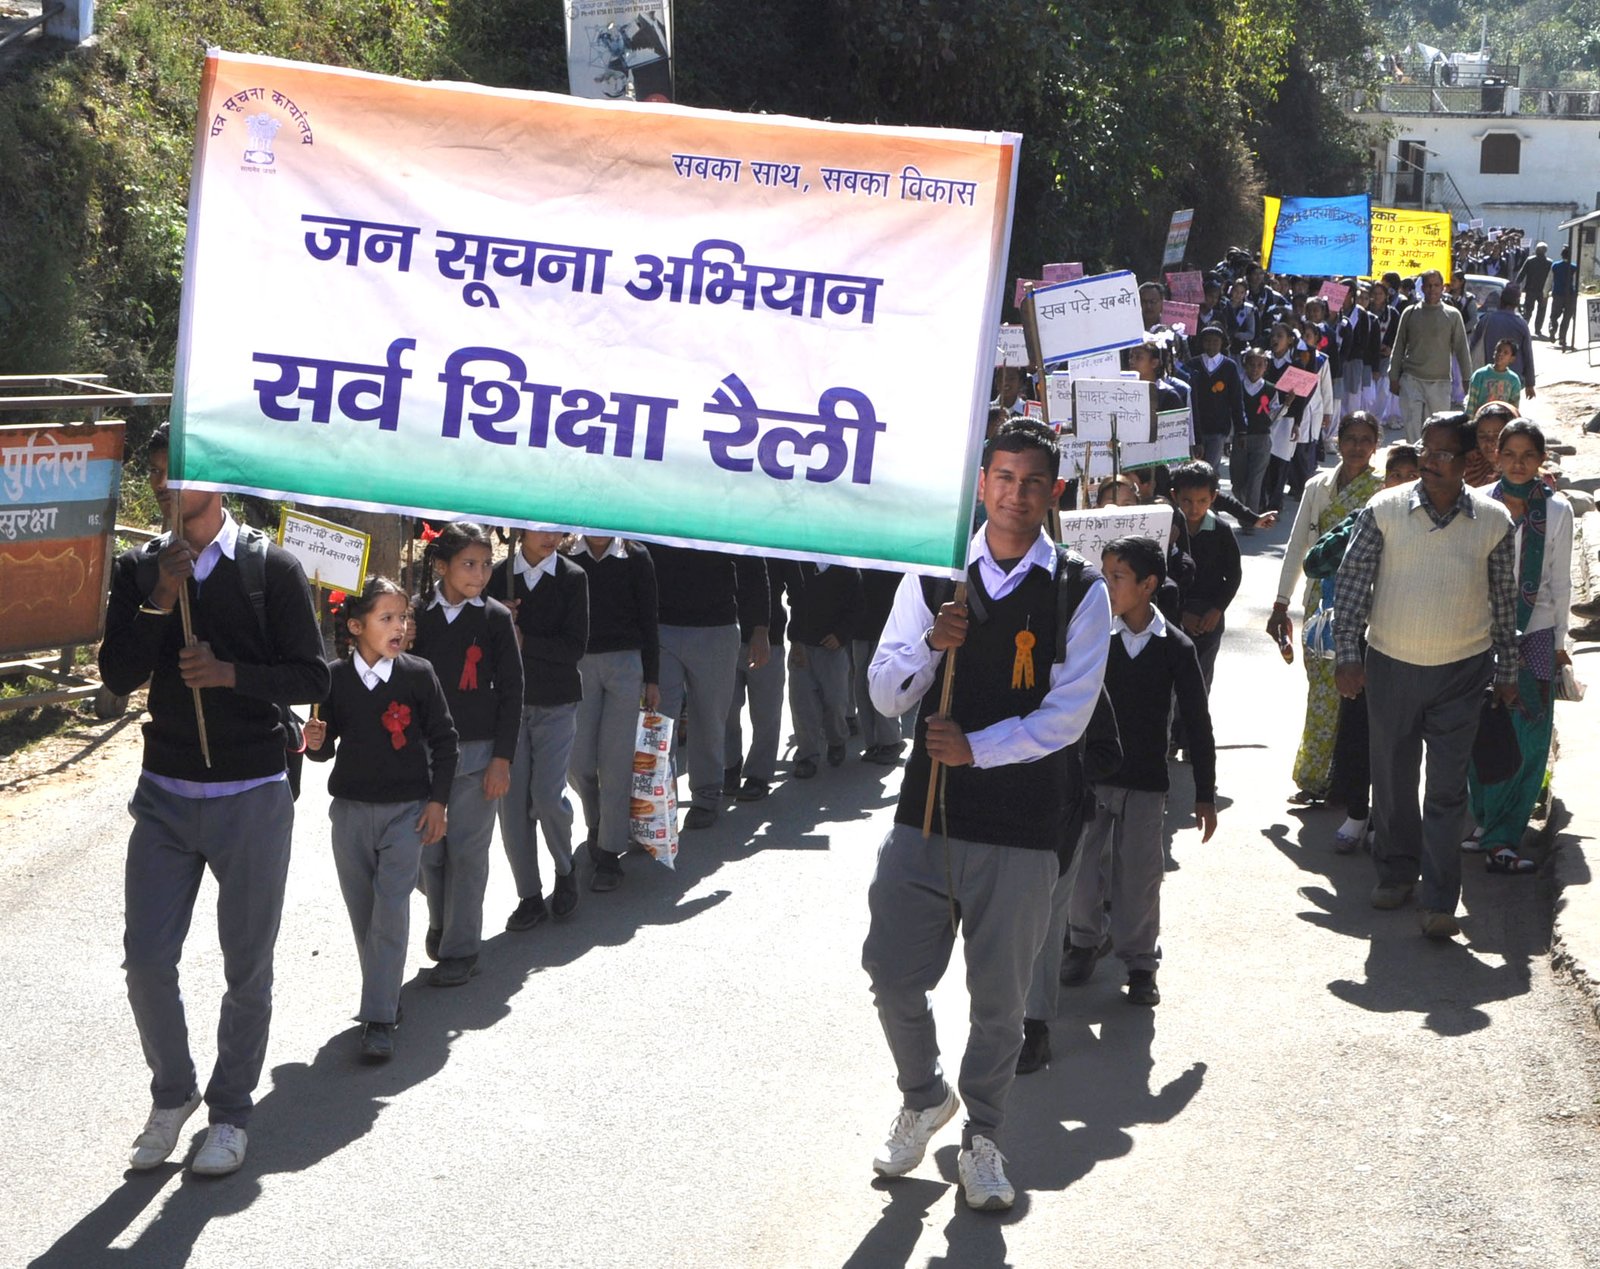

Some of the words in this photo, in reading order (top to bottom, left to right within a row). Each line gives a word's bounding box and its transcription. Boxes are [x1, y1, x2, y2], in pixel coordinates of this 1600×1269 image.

[211, 114, 227, 137] पत्र
[222, 88, 265, 113] सूचना
[272, 89, 313, 146] कार्यालय
[672, 154, 742, 183] सबका
[751, 162, 810, 193] साथ,
[820, 168, 891, 198] सबका
[899, 166, 978, 206] विकास
[301, 214, 421, 272] जन
[435, 231, 613, 309] सूचना
[625, 240, 885, 324] अभियान
[1381, 248, 1395, 257] का
[1399, 249, 1436, 259] आयोजन
[1040, 301, 1067, 320] सब
[1098, 295, 1117, 310] सब
[252, 338, 418, 432] सर्व
[438, 346, 680, 462] शिक्षा
[702, 373, 888, 485] रैली
[1078, 389, 1110, 405] साक्षर
[1110, 387, 1144, 403] चमोली
[1079, 410, 1103, 423] सुन्दर
[1107, 406, 1144, 422] मोली
[2, 430, 95, 501] पुलिस
[1113, 514, 1138, 532] आई
[1138, 513, 1150, 531] है
